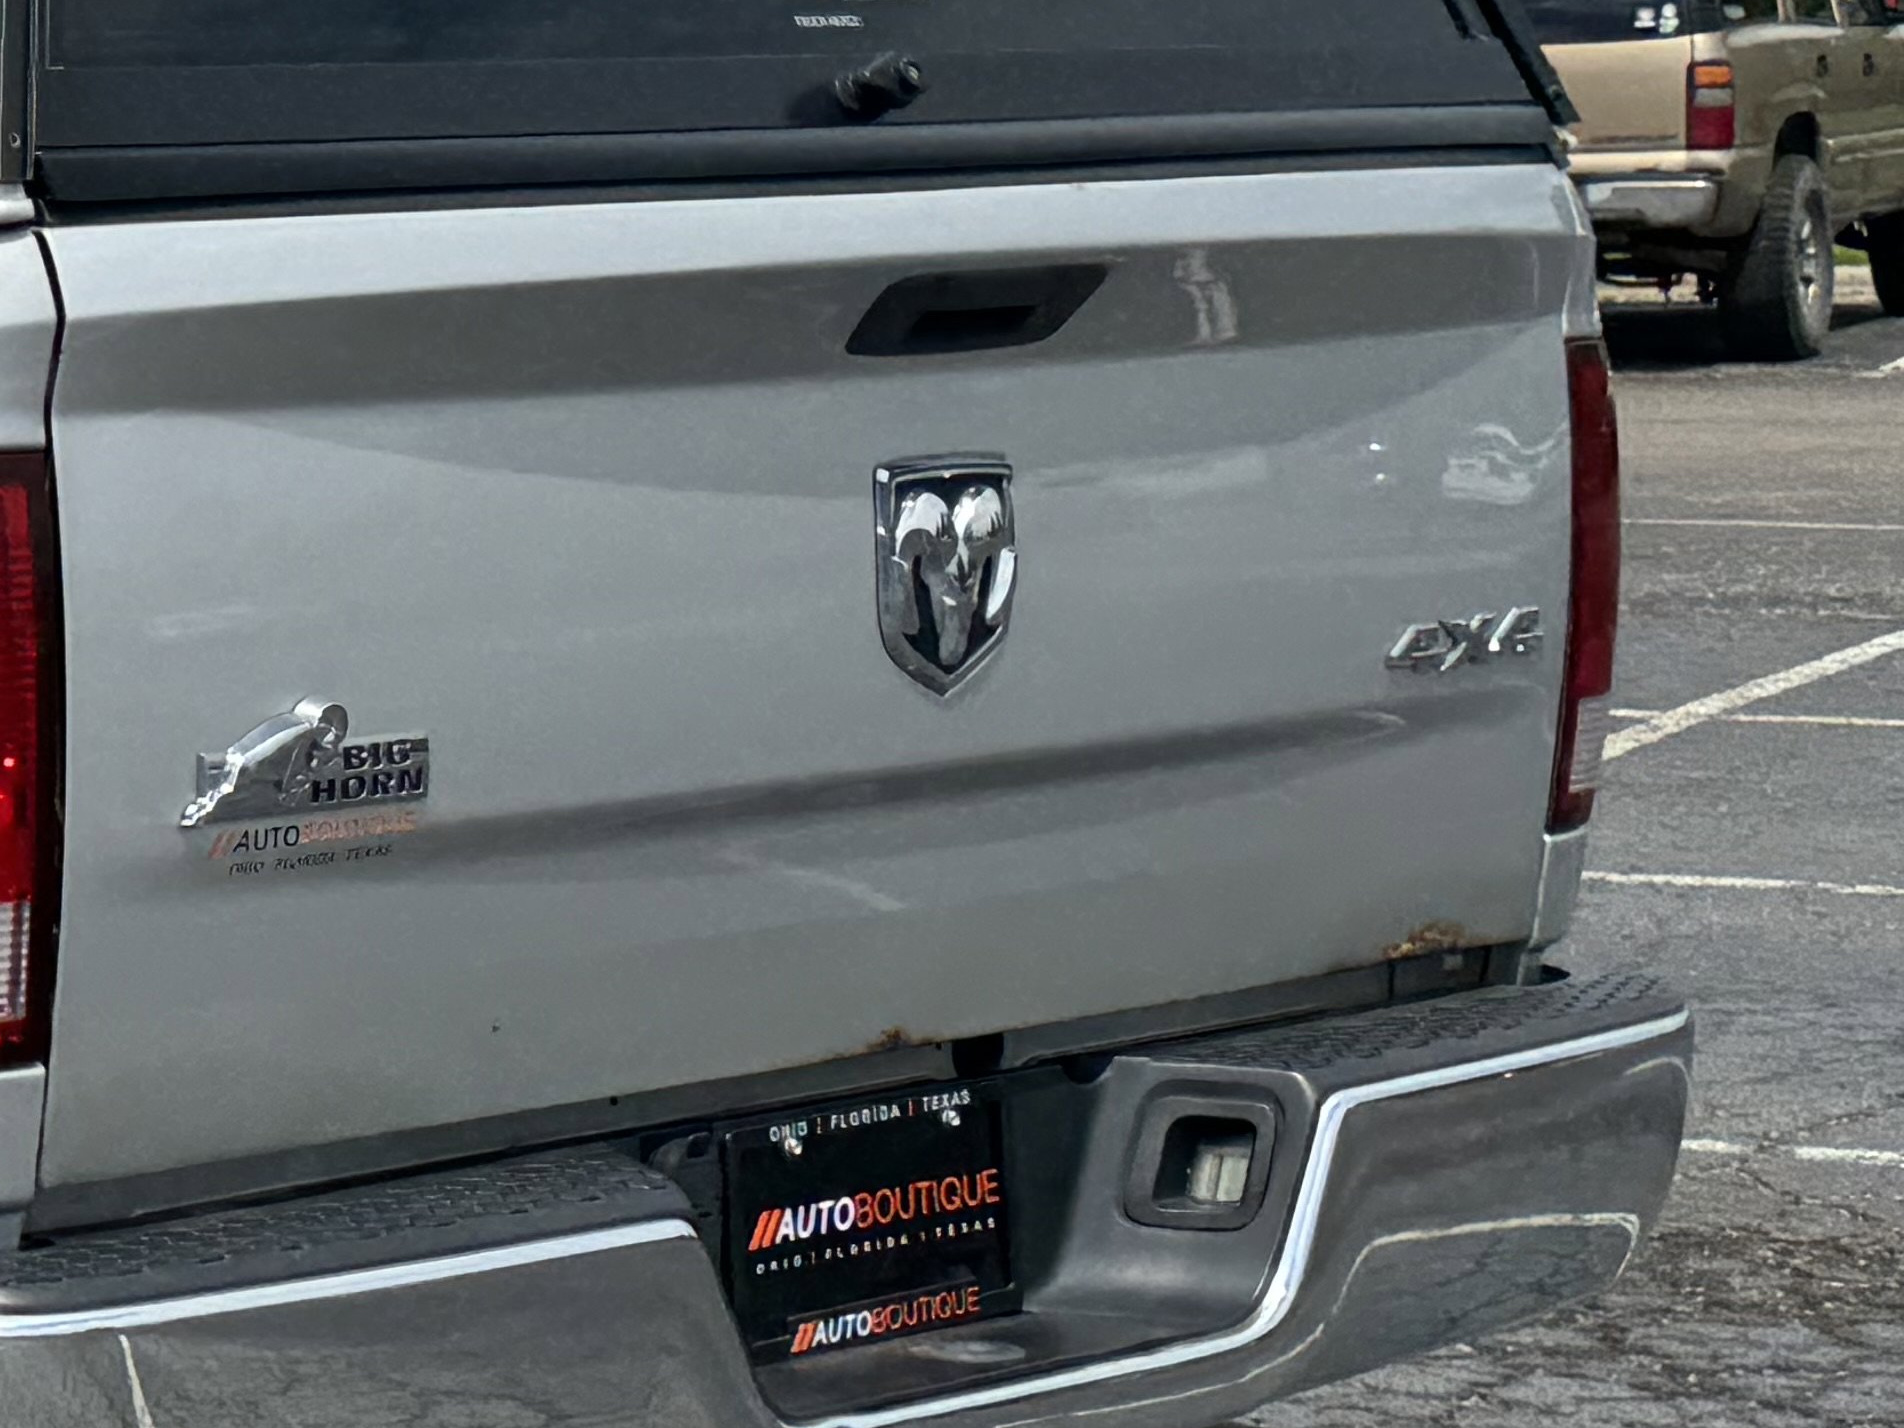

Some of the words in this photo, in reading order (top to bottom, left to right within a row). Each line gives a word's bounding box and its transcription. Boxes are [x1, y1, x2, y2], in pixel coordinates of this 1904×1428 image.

[343, 738, 413, 772] BIG
[310, 767, 424, 804] HORN
[830, 1104, 901, 1130] FLORIDA
[922, 1088, 971, 1113] TEXAS
